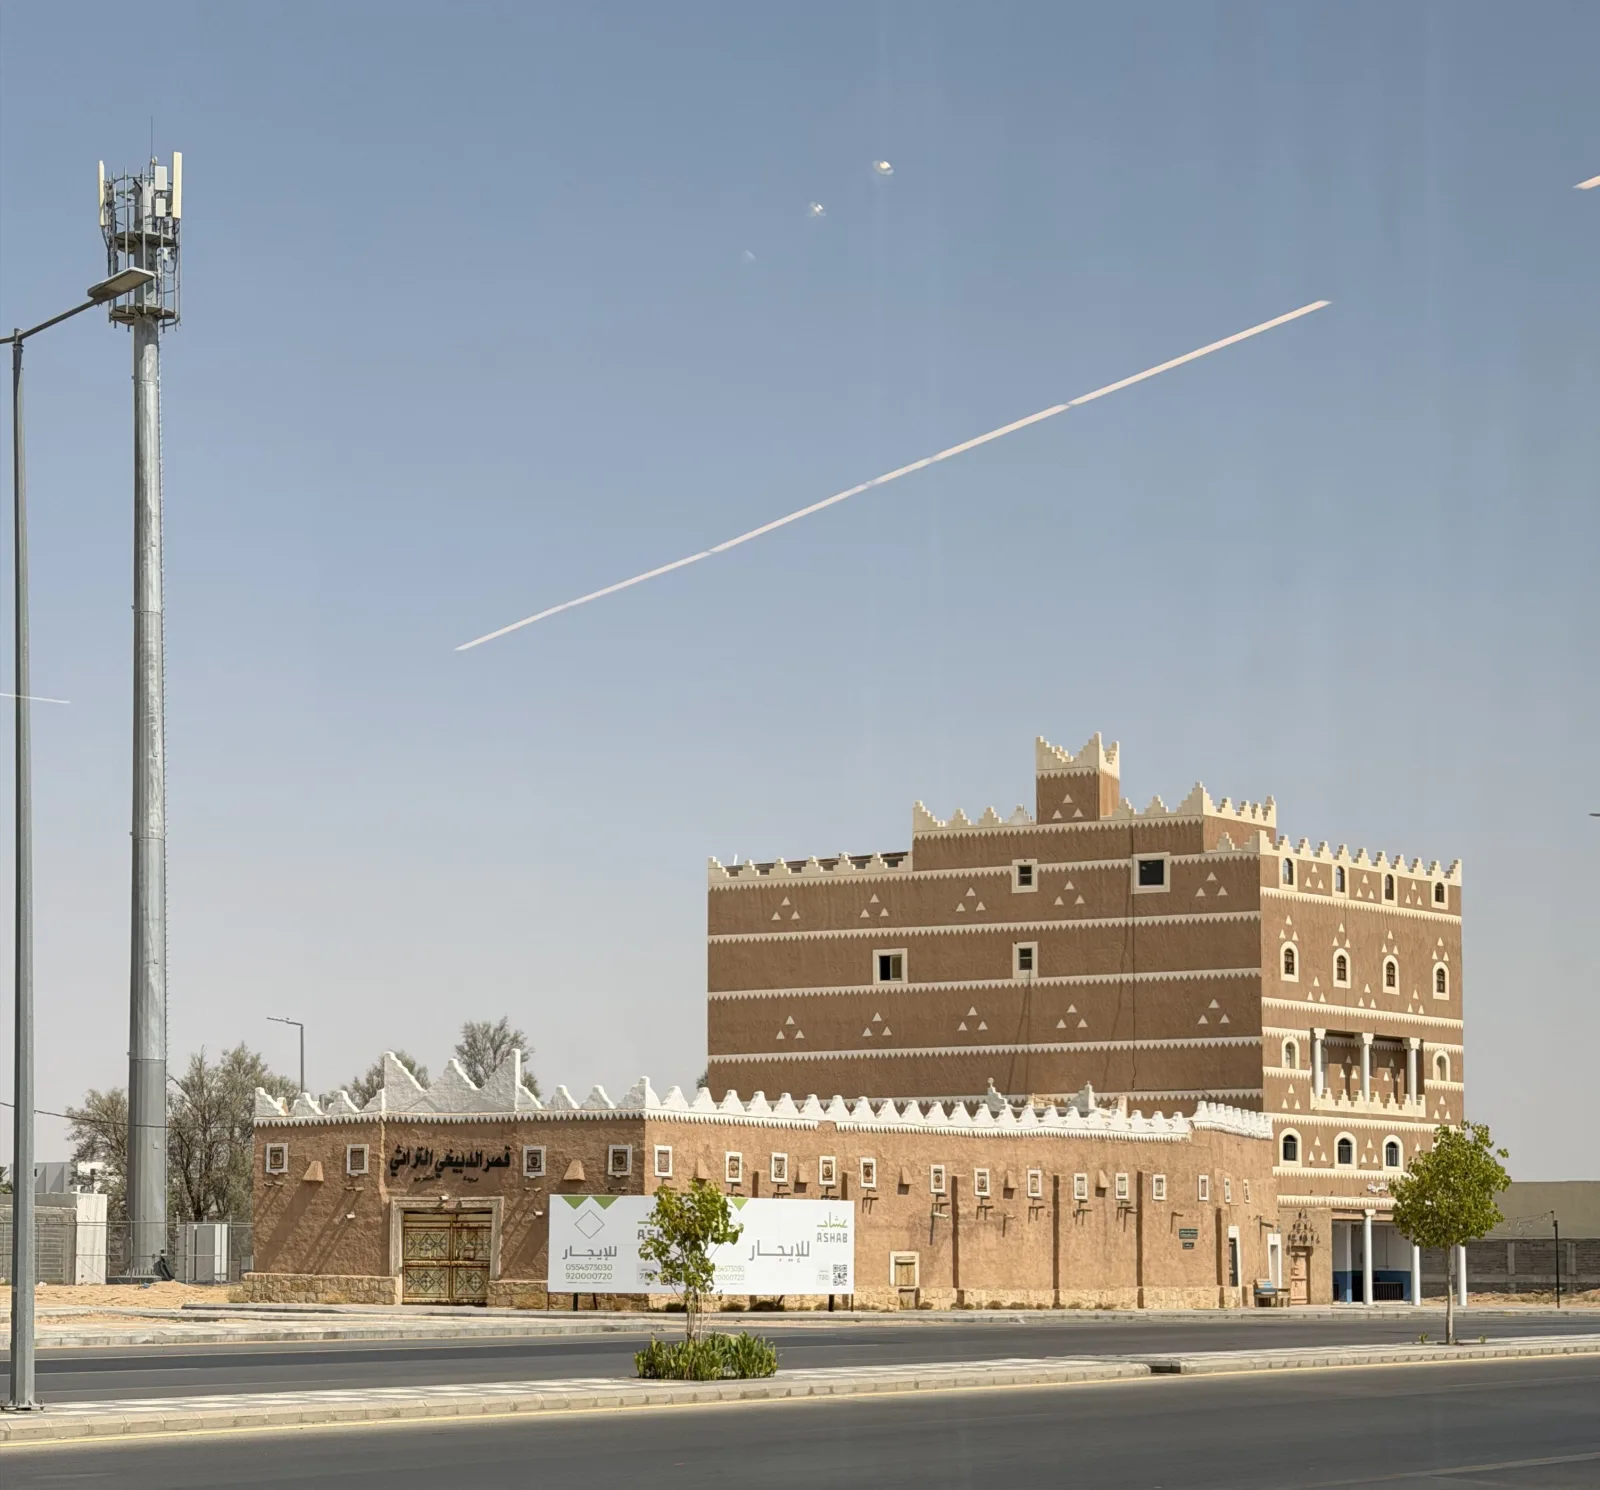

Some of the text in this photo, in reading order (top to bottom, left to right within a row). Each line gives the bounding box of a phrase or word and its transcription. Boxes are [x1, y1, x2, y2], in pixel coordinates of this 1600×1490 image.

[390, 1144, 433, 1177] التراثي
[483, 1145, 512, 1172] قصر
[816, 1232, 848, 1243] ASHAB
[562, 1245, 617, 1260] للإيجار
[748, 1239, 810, 1263] للإيجار
[565, 1263, 613, 1271] 0554573030
[565, 1272, 613, 1280] 920000720
